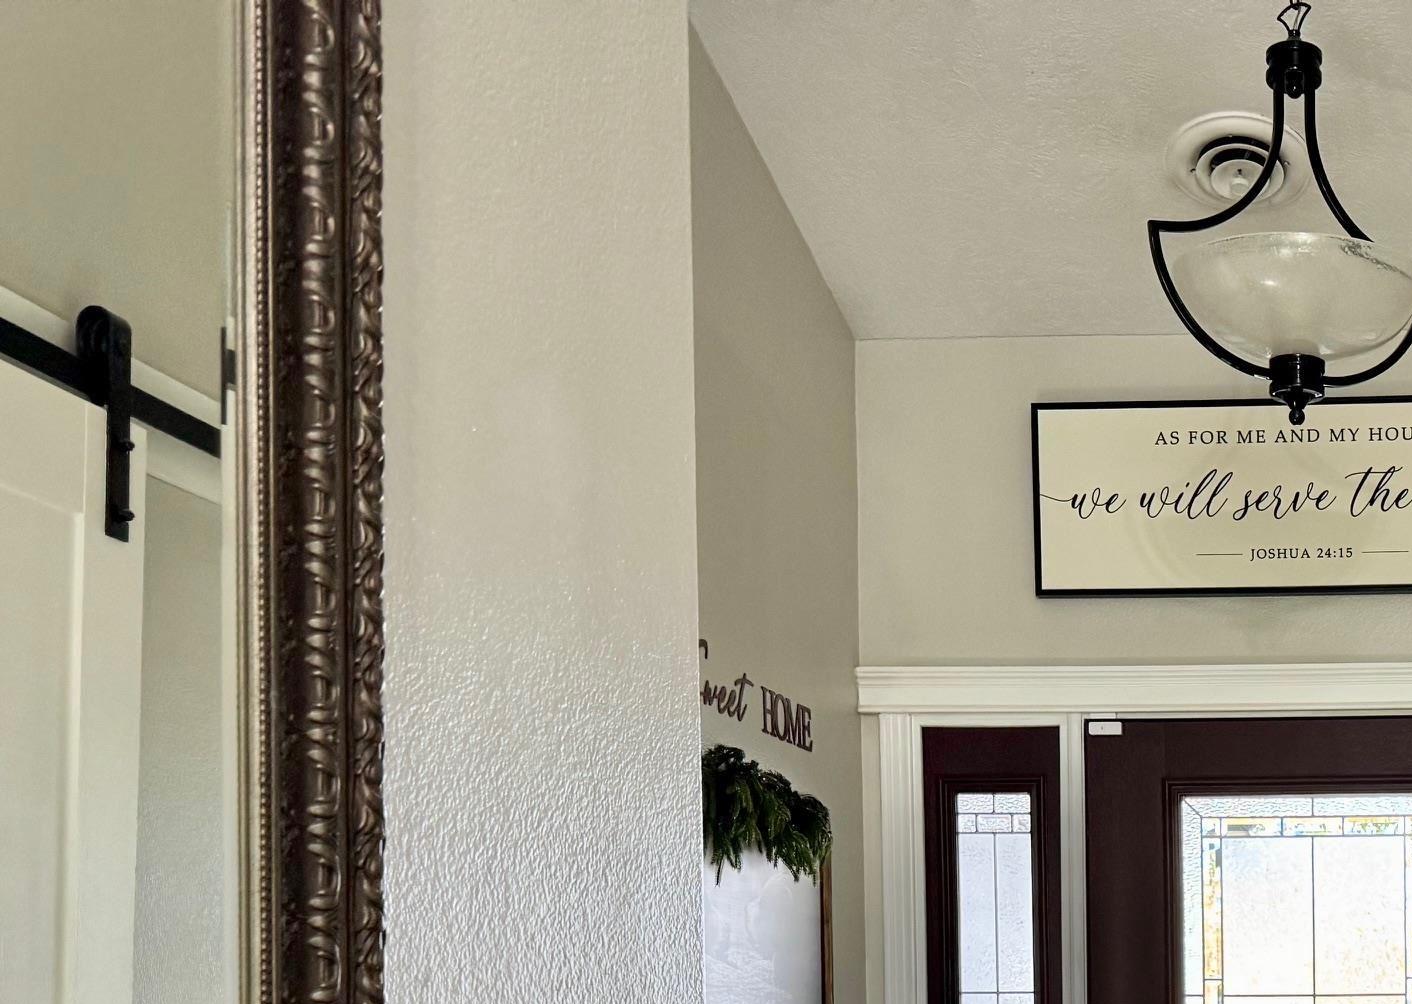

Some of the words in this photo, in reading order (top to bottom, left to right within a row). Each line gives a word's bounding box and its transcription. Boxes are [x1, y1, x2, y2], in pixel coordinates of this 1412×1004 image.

[1154, 430, 1180, 446] AS
[1188, 430, 1229, 445] FOR
[1236, 429, 1267, 444] ME
[1274, 429, 1320, 444] AND
[1329, 427, 1360, 443] MY
[1062, 487, 1127, 520] we
[1139, 468, 1234, 519] will
[1232, 481, 1337, 521] serve
[1249, 547, 1311, 562] JOSHUA
[1316, 547, 1354, 560] 24:15
[760, 685, 813, 753] HOME
